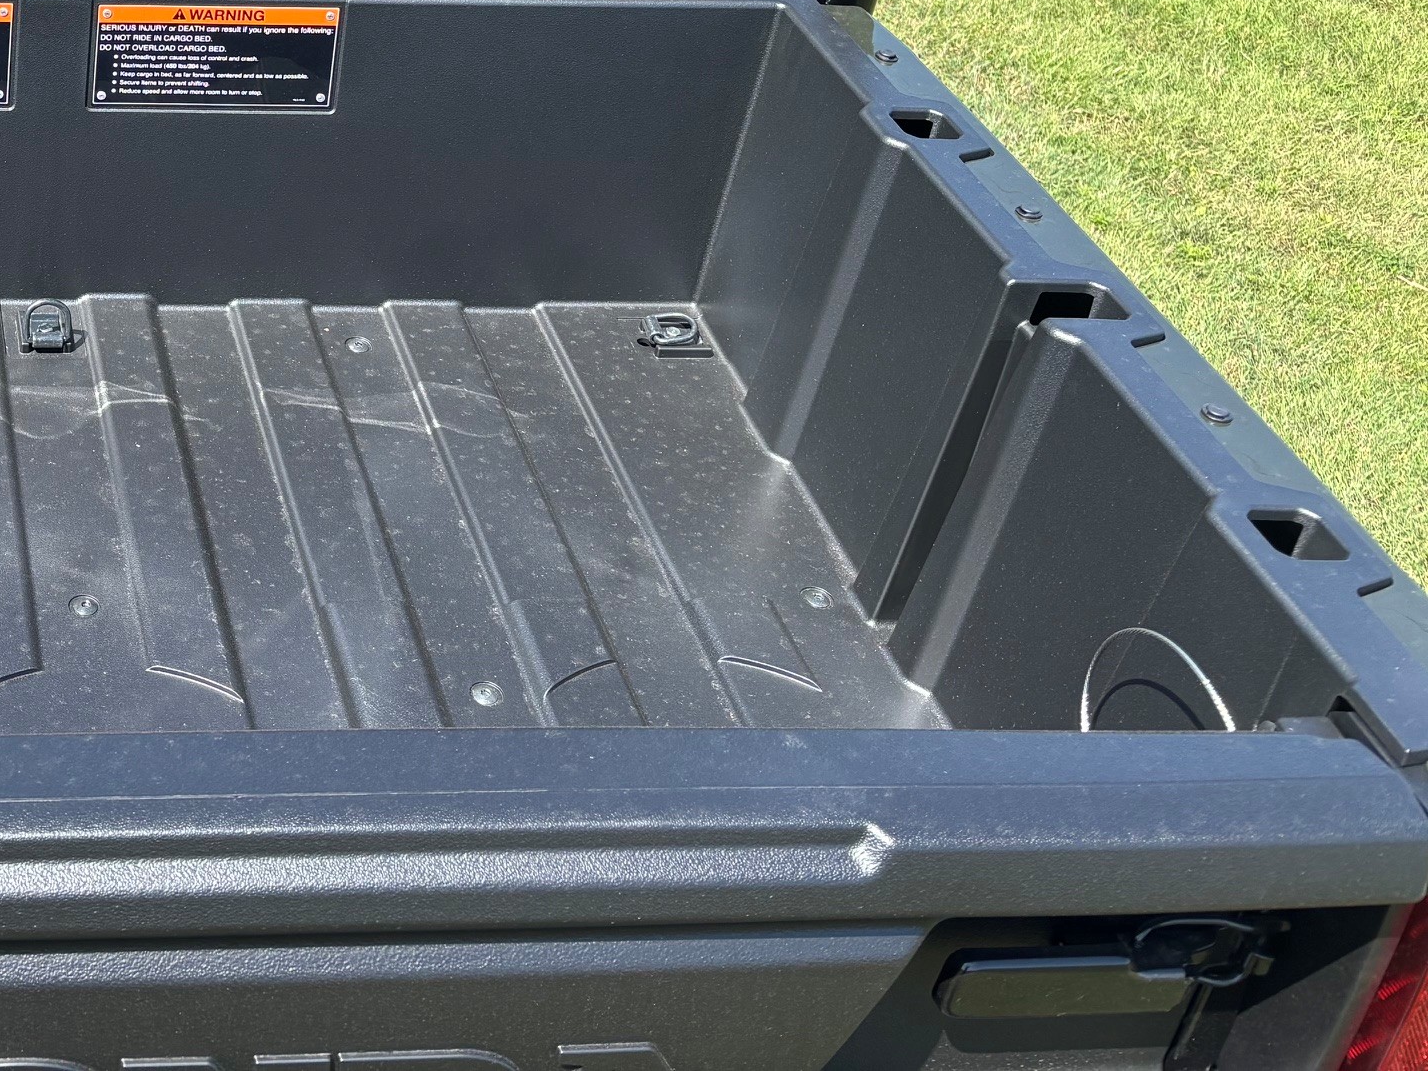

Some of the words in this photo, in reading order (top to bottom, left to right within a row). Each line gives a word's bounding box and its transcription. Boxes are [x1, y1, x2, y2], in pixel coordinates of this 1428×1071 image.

[190, 9, 265, 21] WARNING
[264, 26, 285, 34] ignore
[301, 26, 334, 35] following:
[121, 54, 155, 62] Overloading
[188, 80, 210, 88] shifting.
[249, 89, 262, 97] stop.
